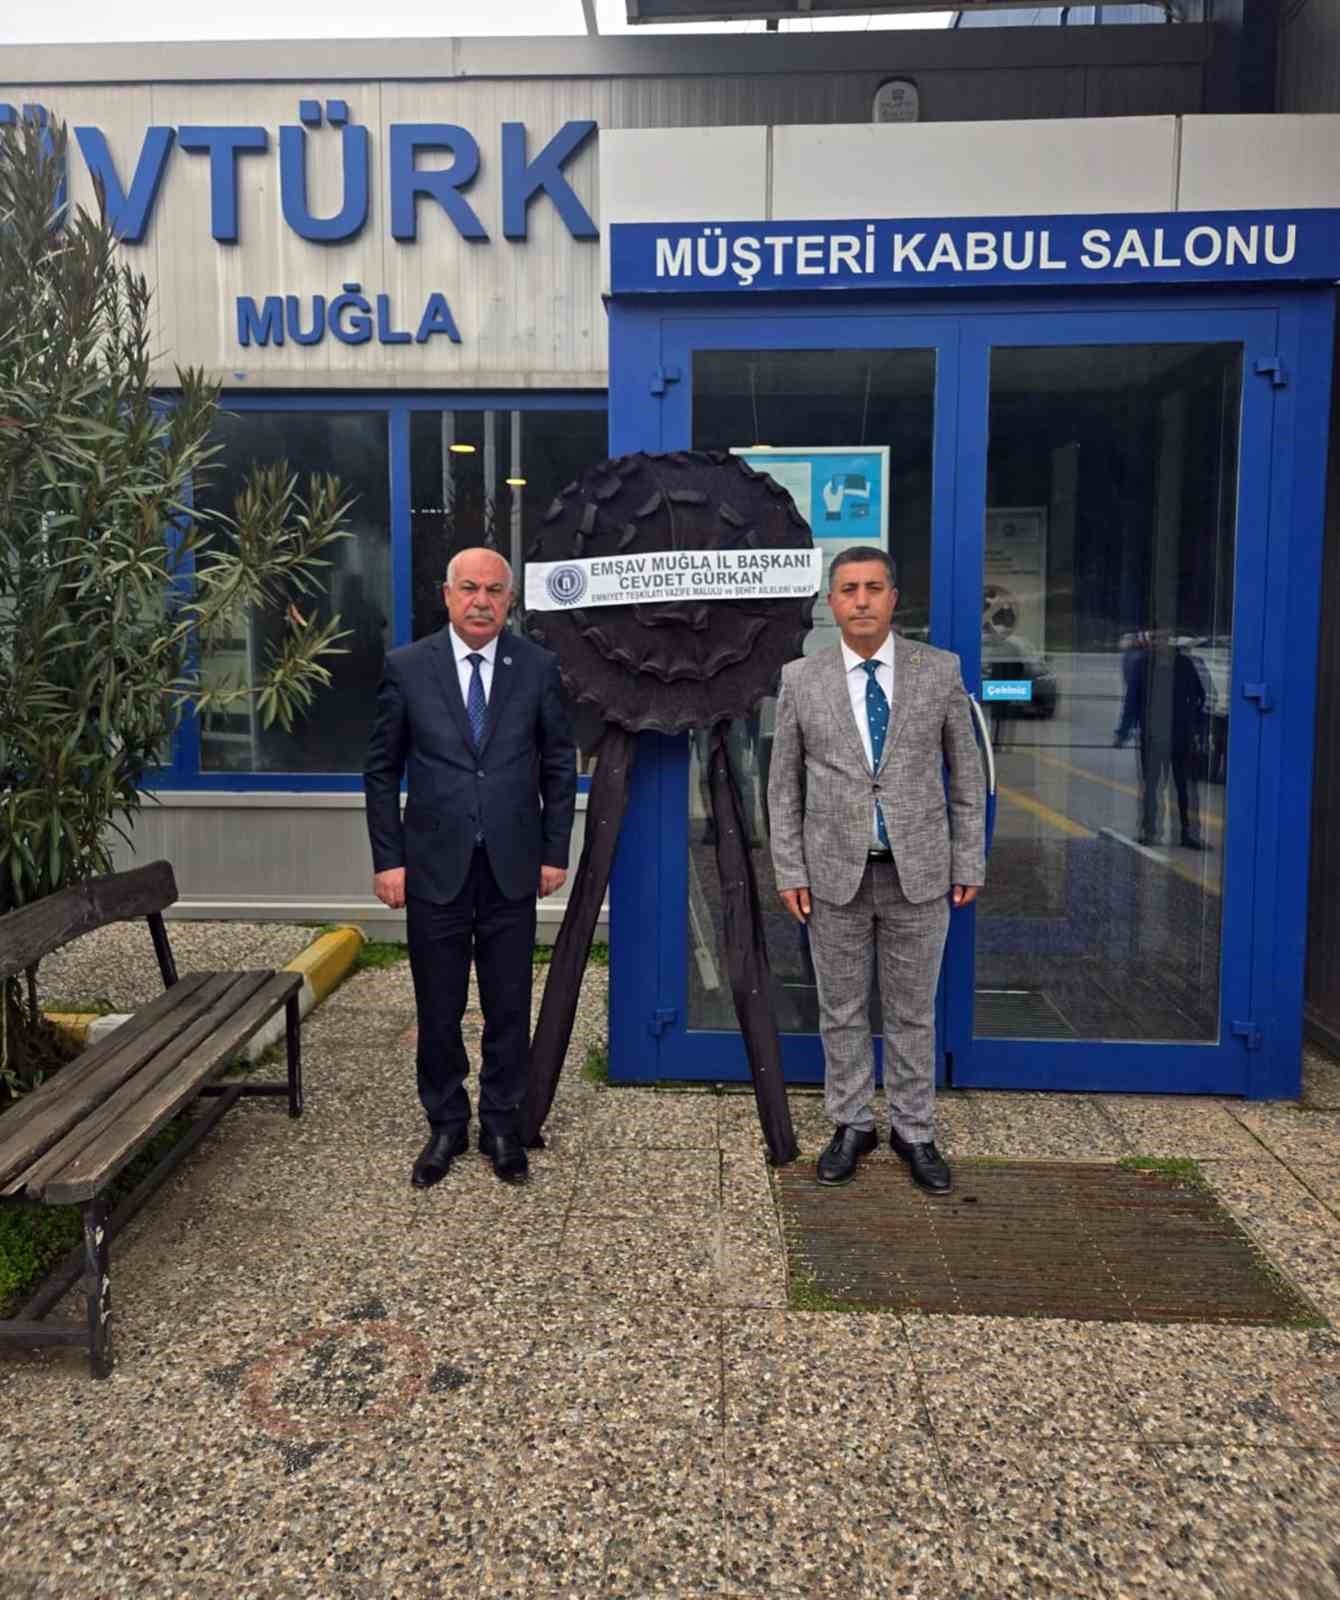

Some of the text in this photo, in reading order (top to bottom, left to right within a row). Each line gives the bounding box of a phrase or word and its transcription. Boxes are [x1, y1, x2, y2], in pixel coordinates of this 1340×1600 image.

[655, 224, 1296, 286] MÜŞTERİ KABUL SALONU
[236, 283, 462, 346] MUĞLA
[590, 558, 646, 577] EMŞAV
[651, 551, 712, 572] MUĞLA
[737, 553, 811, 573] BAŞKANI
[619, 572, 686, 590] CEVDET
